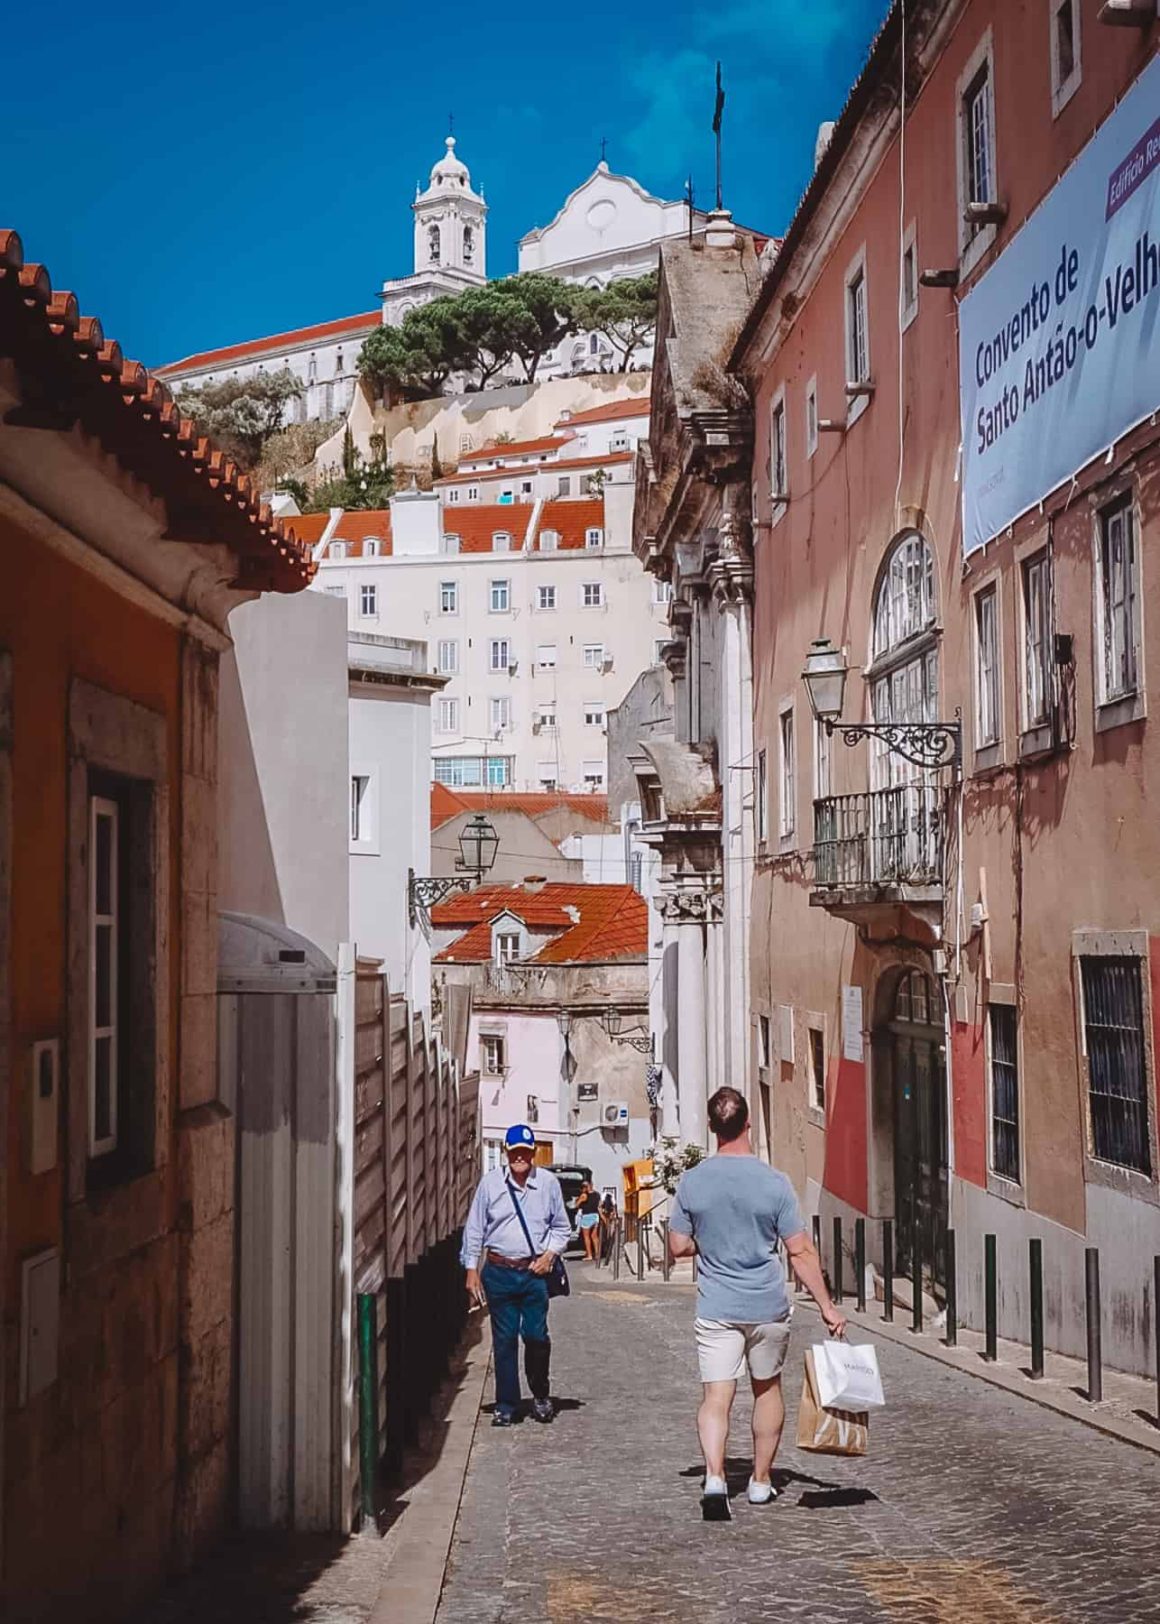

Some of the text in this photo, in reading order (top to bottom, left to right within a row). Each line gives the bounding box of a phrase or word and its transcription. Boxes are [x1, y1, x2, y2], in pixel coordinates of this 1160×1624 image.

[1110, 134, 1160, 206] Edifício Re
[975, 243, 1079, 388] Convento de
[977, 230, 1160, 455] Santo Antão-o-Velh
